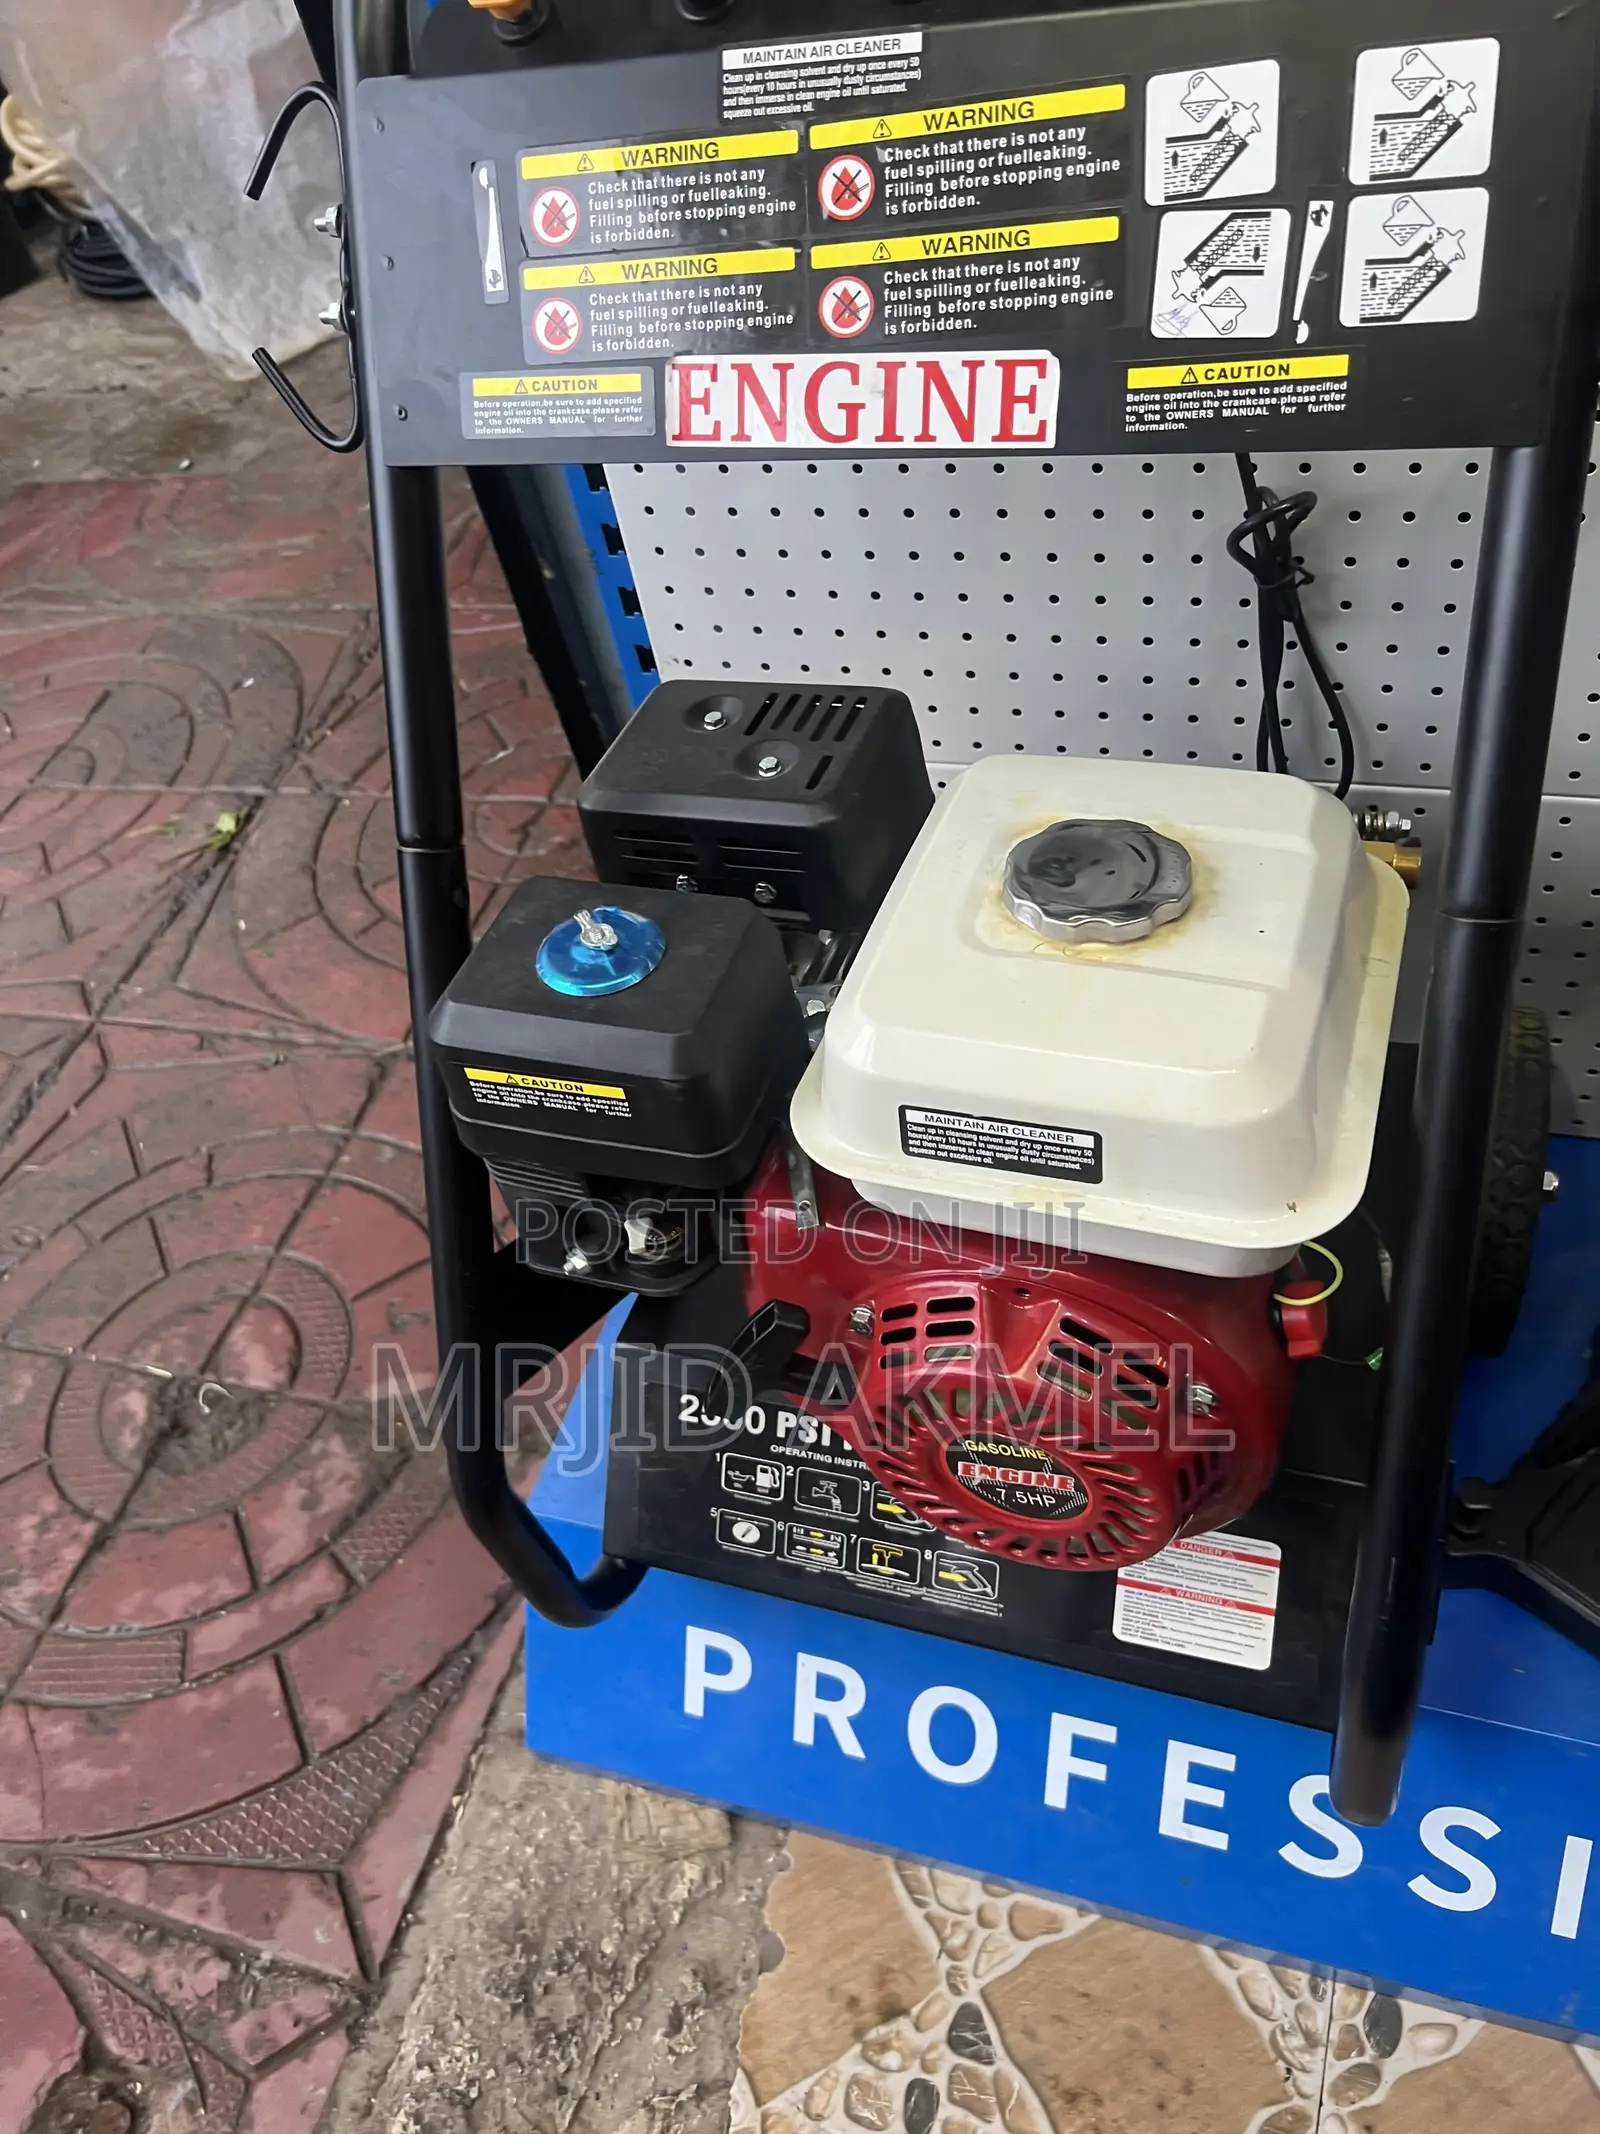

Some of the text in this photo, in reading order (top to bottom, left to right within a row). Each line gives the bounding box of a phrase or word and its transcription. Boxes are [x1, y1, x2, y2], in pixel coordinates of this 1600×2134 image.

[743, 38, 901, 64] MAINTAIN AIR CLEANER
[923, 102, 1034, 130] WARNING
[621, 142, 719, 166] WARNING
[883, 127, 1086, 162] Check that there is not any
[884, 145, 1092, 180] fuel spilling or fuelleaking.
[588, 169, 765, 194] Check that there is not any
[885, 160, 1120, 198] Filling before stopping engine
[588, 186, 771, 211] fuel spilling or fuelleaking.
[885, 195, 980, 216] is forbidden.
[589, 201, 796, 228] Filling before stopping engine
[590, 227, 675, 244] is forbidden.
[921, 230, 1030, 255] WARNING
[621, 258, 718, 279] WARNING
[883, 257, 1080, 284] Check that there is not any
[589, 284, 763, 306] Check that there is not any
[883, 274, 1086, 301] fuel spilling or fuelleaking.
[590, 300, 768, 321] fuel spilling or fuelleaking.
[884, 290, 1114, 318] Filling before stopping engine
[591, 314, 794, 337] Filling before stopping engine
[884, 318, 977, 335] is forbidden.
[592, 338, 674, 352] is forbidden.
[1204, 364, 1290, 380] CAUTION
[532, 379, 597, 392] CAUTION
[1126, 393, 1161, 402] Before
[1232, 388, 1257, 396] sure
[1259, 386, 1271, 395] to
[1273, 384, 1294, 394] add
[1296, 381, 1347, 394] specified
[671, 358, 1047, 443] ENGINE
[1125, 403, 1161, 414] engine
[1163, 401, 1177, 410] oil
[1179, 401, 1200, 409] into
[1202, 399, 1220, 408] the
[1319, 393, 1346, 402] refer
[1125, 403, 1347, 422] to the OWNERS MANUAL for further
[1125, 422, 1188, 432] information.
[521, 1078, 584, 1092] CAUTION
[924, 1114, 1074, 1143] MAINTAIN AIR CLEANER
[776, 1410, 832, 1446] PSI
[715, 1452, 721, 1462] 1
[770, 1444, 871, 1471] OPERATING INSTR
[965, 1439, 1048, 1461] GASOLINE
[786, 1466, 794, 1476] 2
[958, 1461, 1075, 1491] ENGINE
[862, 1481, 870, 1491] 3
[710, 1507, 718, 1517] 5
[777, 1521, 785, 1531] 6
[924, 1550, 932, 1560] 8
[1180, 1541, 1222, 1557] DANGER
[1175, 1588, 1223, 1606] WARNING
